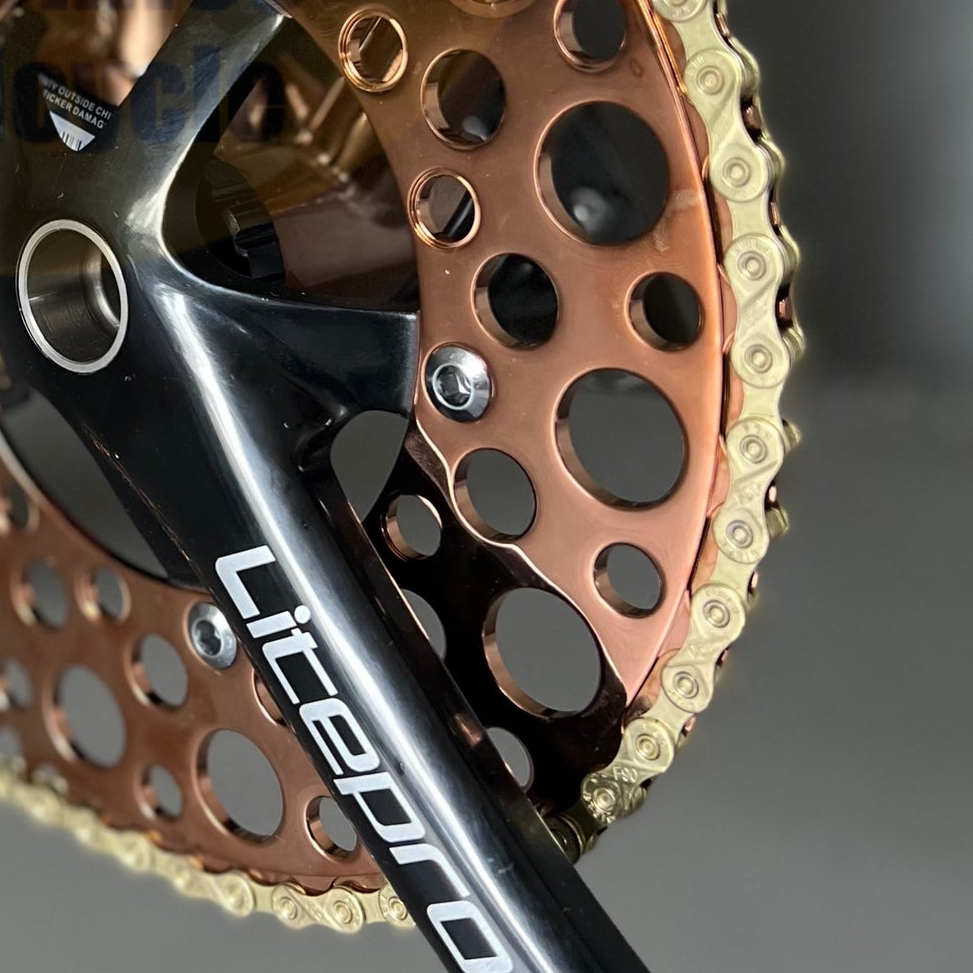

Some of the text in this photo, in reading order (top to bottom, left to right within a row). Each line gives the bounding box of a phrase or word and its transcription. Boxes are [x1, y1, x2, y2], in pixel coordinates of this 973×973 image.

[57, 85, 96, 113] OUTSIDE
[72, 107, 107, 130] DAMAG
[214, 544, 513, 973] Litepro
